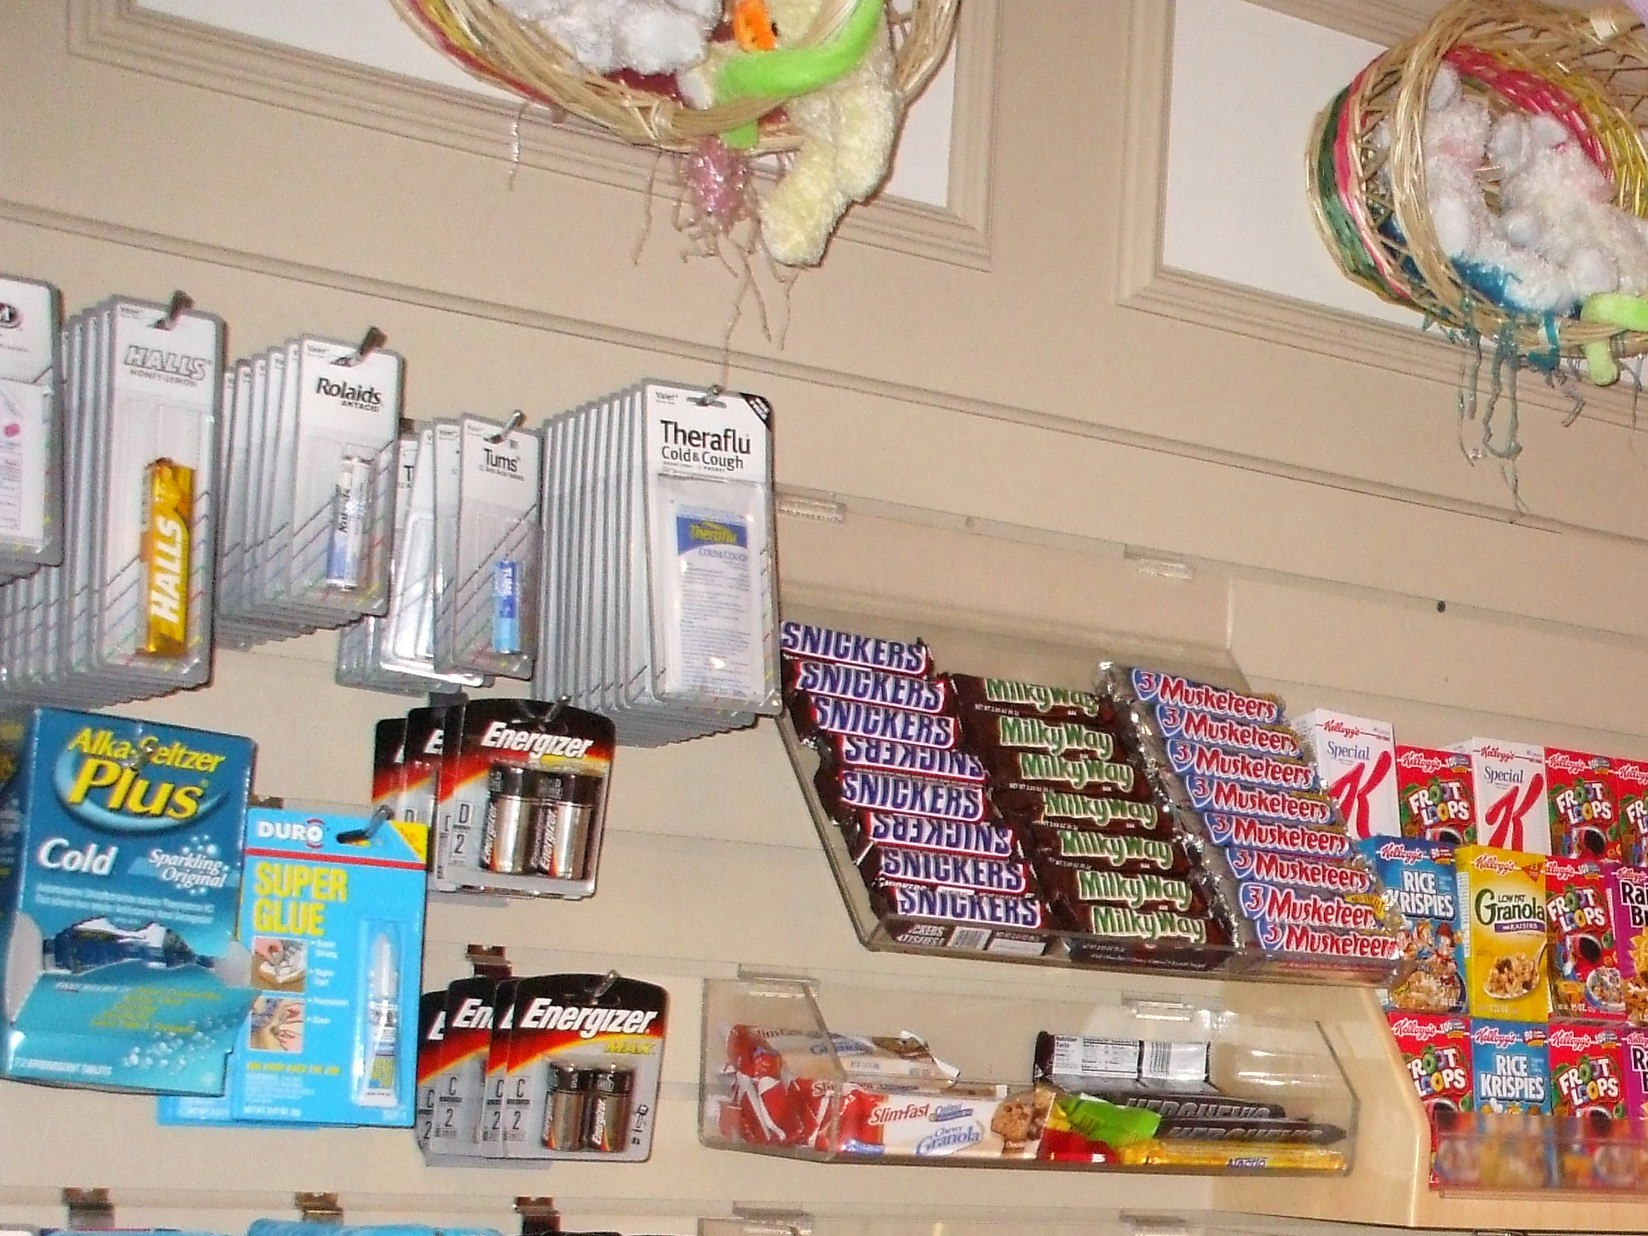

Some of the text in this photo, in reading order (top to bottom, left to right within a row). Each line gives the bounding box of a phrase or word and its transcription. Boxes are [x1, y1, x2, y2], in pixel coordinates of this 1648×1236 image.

[316, 378, 382, 406] Rolaids
[660, 420, 750, 455] Theraflu
[484, 449, 517, 472] Tums
[148, 517, 188, 626] HALLS
[783, 622, 925, 673] SNICKERS
[800, 662, 942, 712] SNICKERS
[1140, 672, 1276, 721] 3 Musketeers
[816, 698, 952, 745] SNICKERS
[1323, 721, 1361, 738] Kellogg's
[481, 722, 594, 759] Energizer
[845, 737, 985, 779] SNICKERS
[1327, 741, 1370, 761] Special
[1176, 743, 1312, 788] 3 Musketeers
[1402, 751, 1442, 773] Kellogg's
[1484, 766, 1524, 784] Special
[68, 758, 204, 820] Plus
[1196, 778, 1331, 823] 3 Musketeers
[258, 821, 323, 845] DURO
[38, 838, 118, 876] Cold
[149, 849, 224, 874] Sparkling
[161, 865, 228, 890] Original
[254, 862, 349, 902] SUPER
[1403, 871, 1437, 894] RICE
[253, 901, 325, 936] GLUE
[1475, 889, 1545, 925] Granola
[520, 998, 658, 1039] Energizer
[1496, 1054, 1527, 1077] RICE
[1480, 1073, 1546, 1101] KRISPIES
